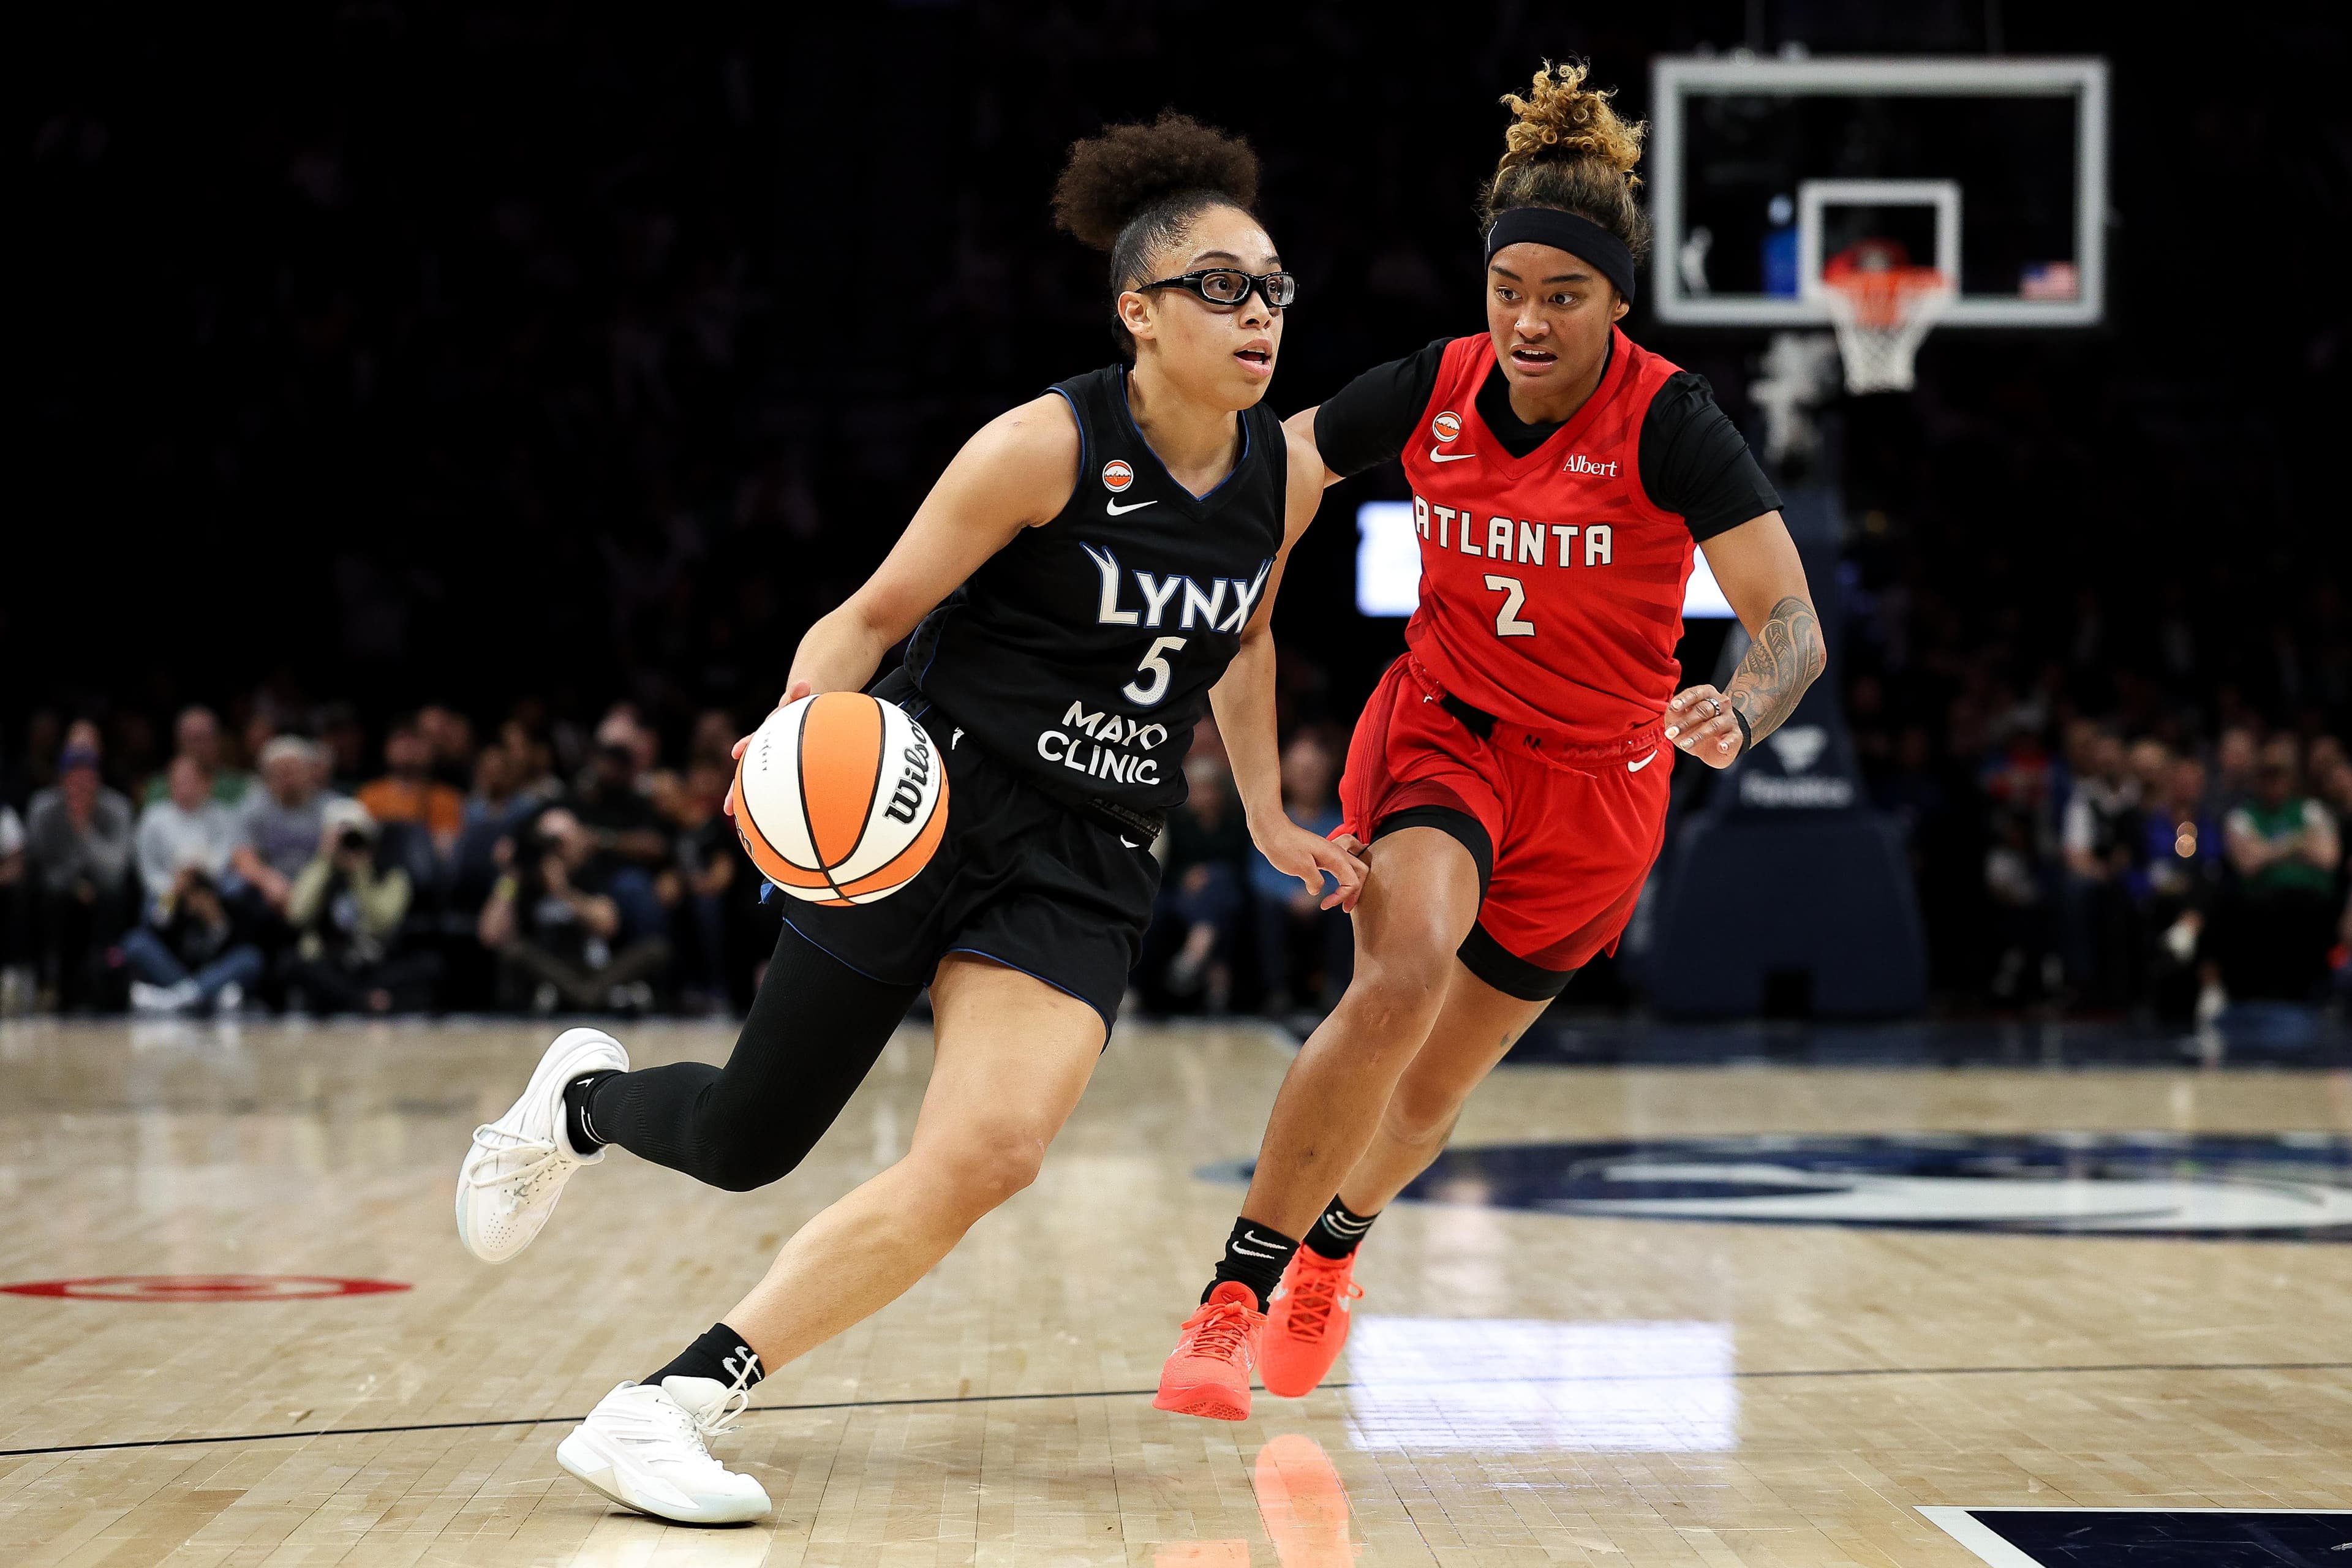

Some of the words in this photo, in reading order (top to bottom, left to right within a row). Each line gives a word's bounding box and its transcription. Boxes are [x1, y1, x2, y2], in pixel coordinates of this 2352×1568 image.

[1562, 454, 1618, 477] Albert
[1414, 494, 1613, 567] ATLANTA
[1080, 541, 1273, 635] LYNX
[1483, 573, 1536, 637] 2
[1120, 635, 1189, 707] 5
[1061, 700, 1167, 750] MAYO
[1038, 730, 1160, 785] CLINIC
